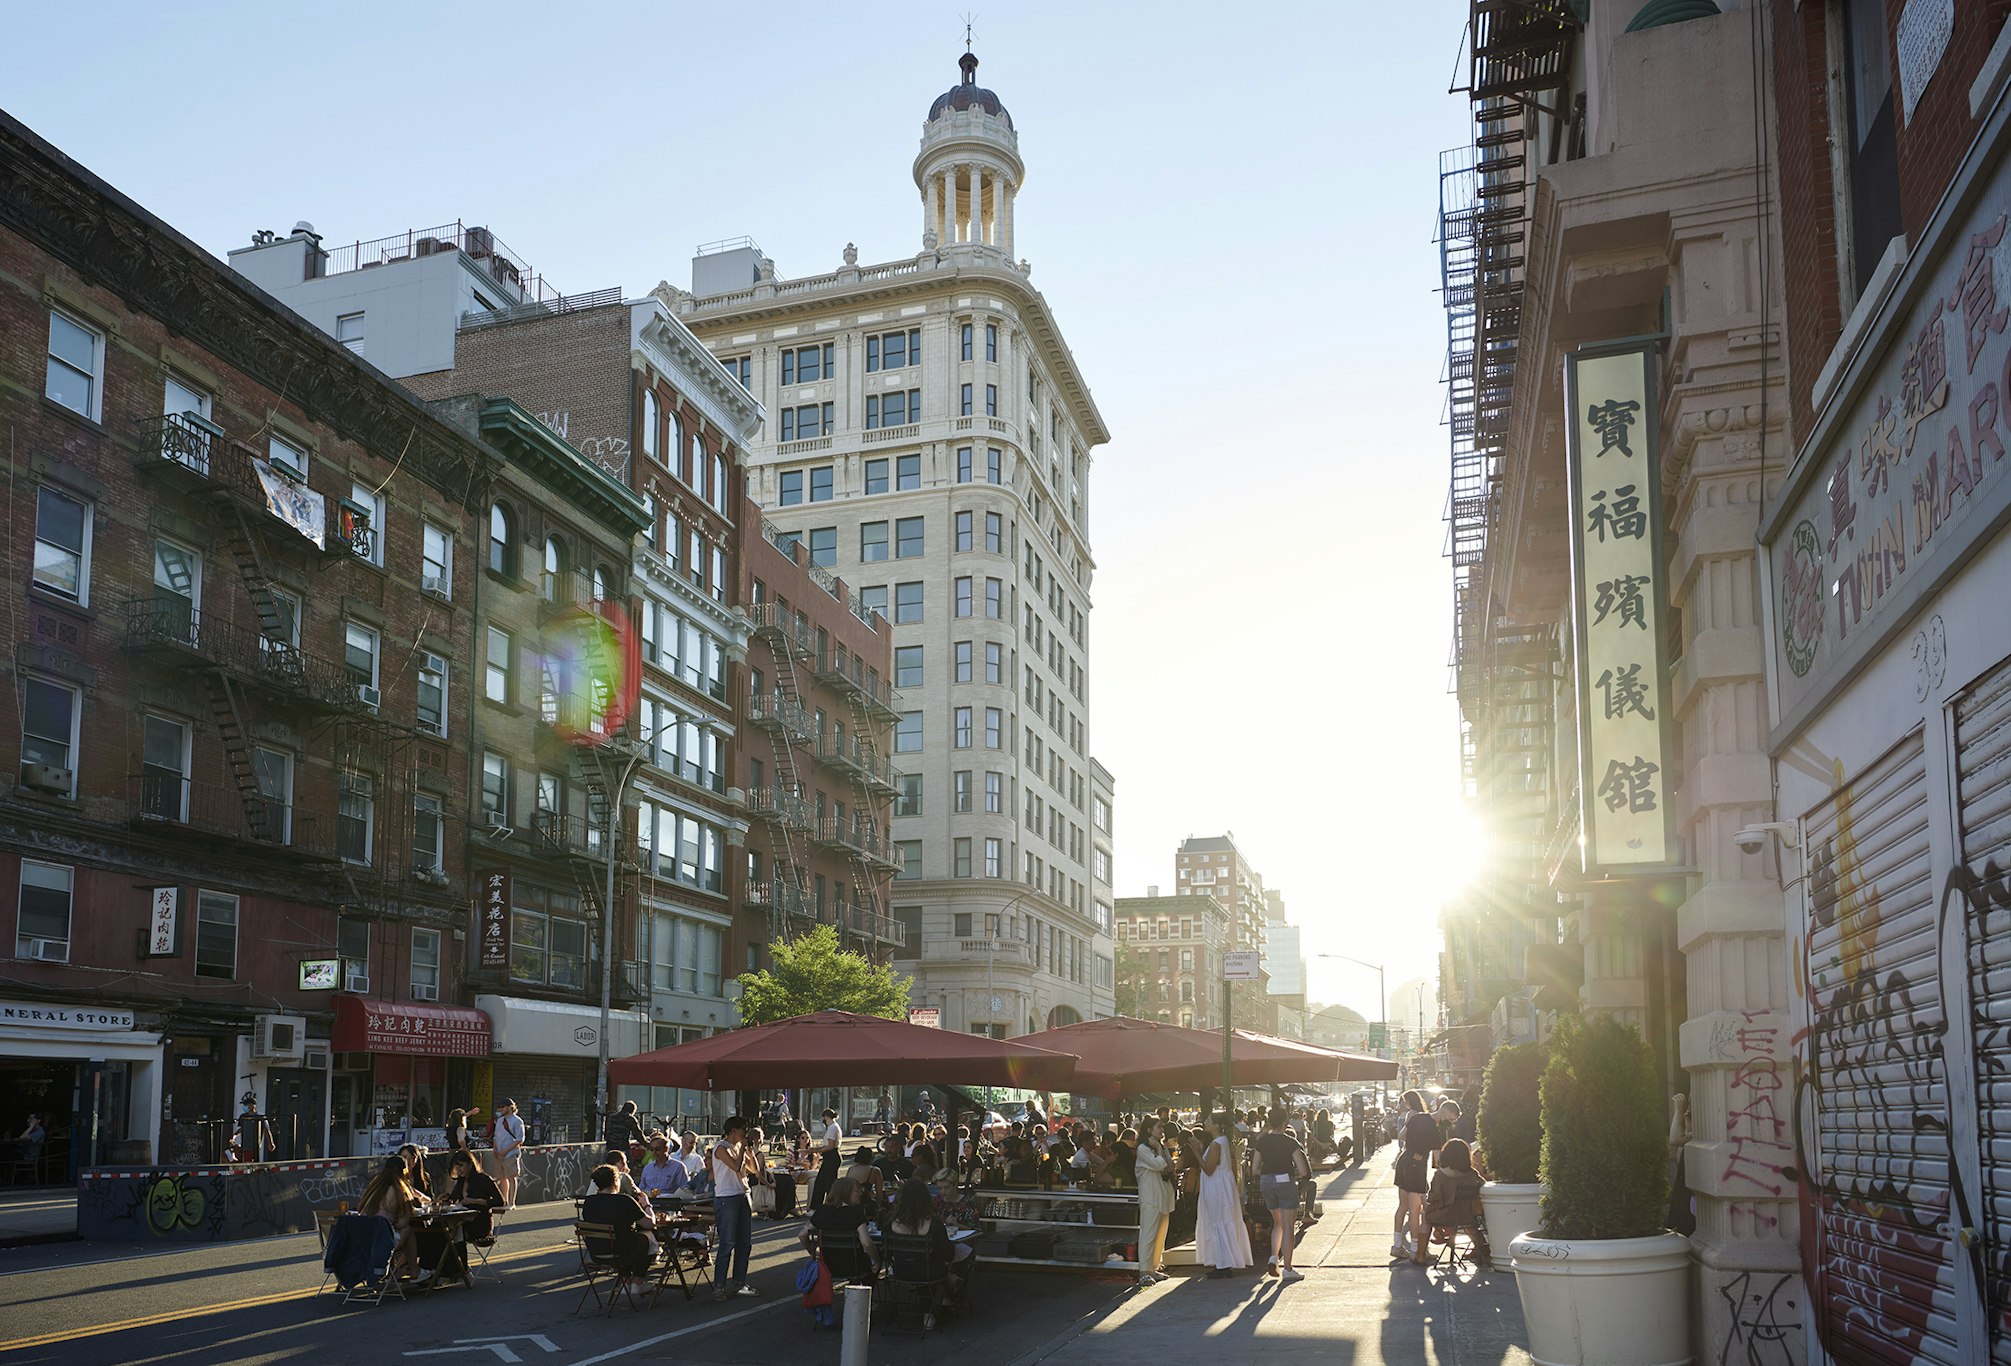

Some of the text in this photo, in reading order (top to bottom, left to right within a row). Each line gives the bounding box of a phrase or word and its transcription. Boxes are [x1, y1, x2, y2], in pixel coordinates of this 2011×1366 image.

[1833, 500, 1905, 640] TWIN
[0, 1008, 131, 1025] NERAL STORE
[576, 1031, 595, 1041] LABOR
[536, 1104, 542, 1112] P
